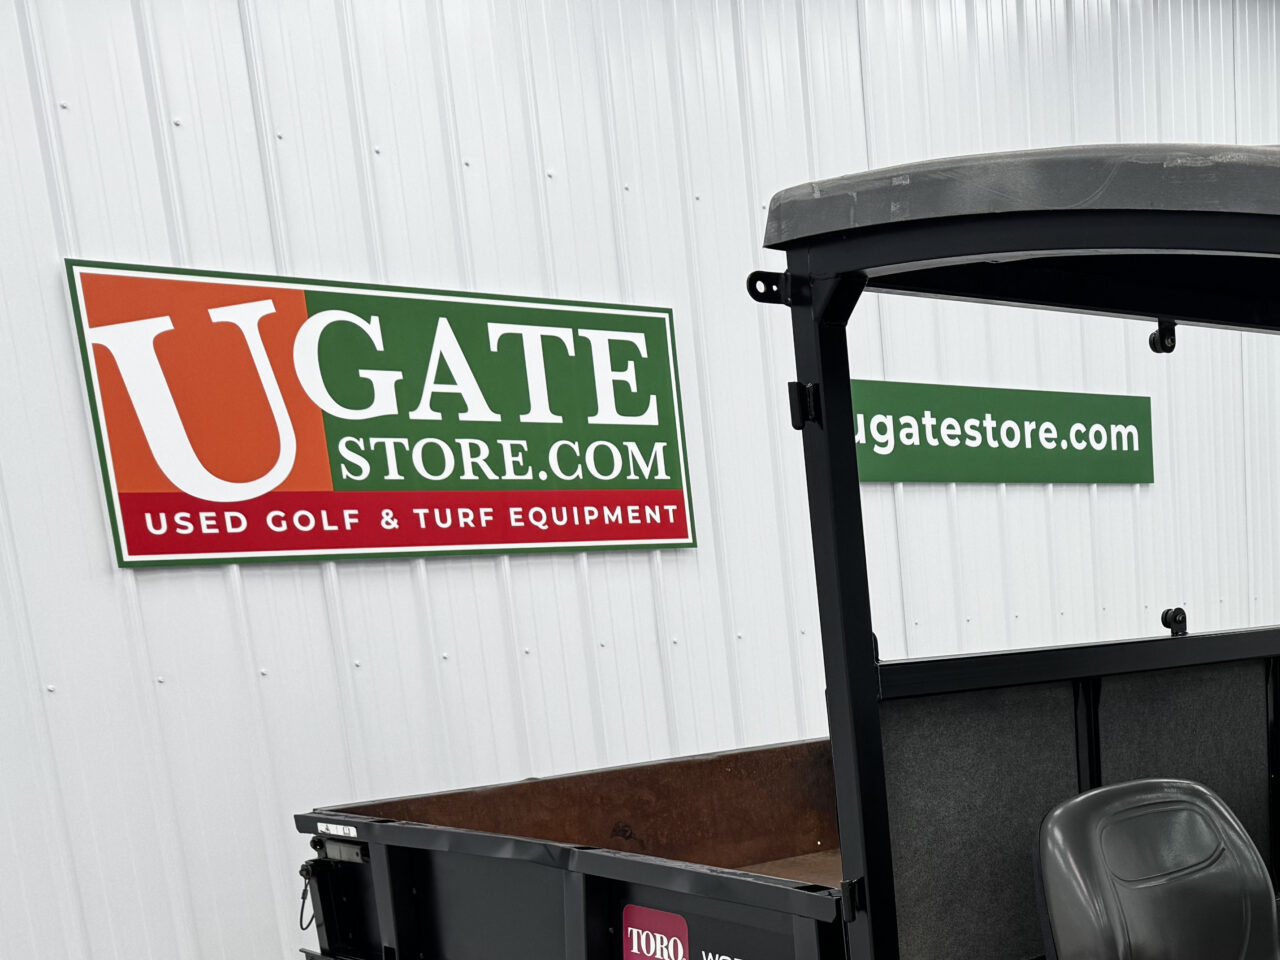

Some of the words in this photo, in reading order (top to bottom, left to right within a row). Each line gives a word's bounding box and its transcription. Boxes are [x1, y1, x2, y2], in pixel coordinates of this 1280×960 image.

[337, 435, 671, 481] STORE.COM
[145, 511, 248, 535] USED
[266, 508, 359, 532] GOLF
[380, 508, 400, 530] &
[413, 507, 495, 529] TURF
[509, 504, 677, 528] EQUIPMENT
